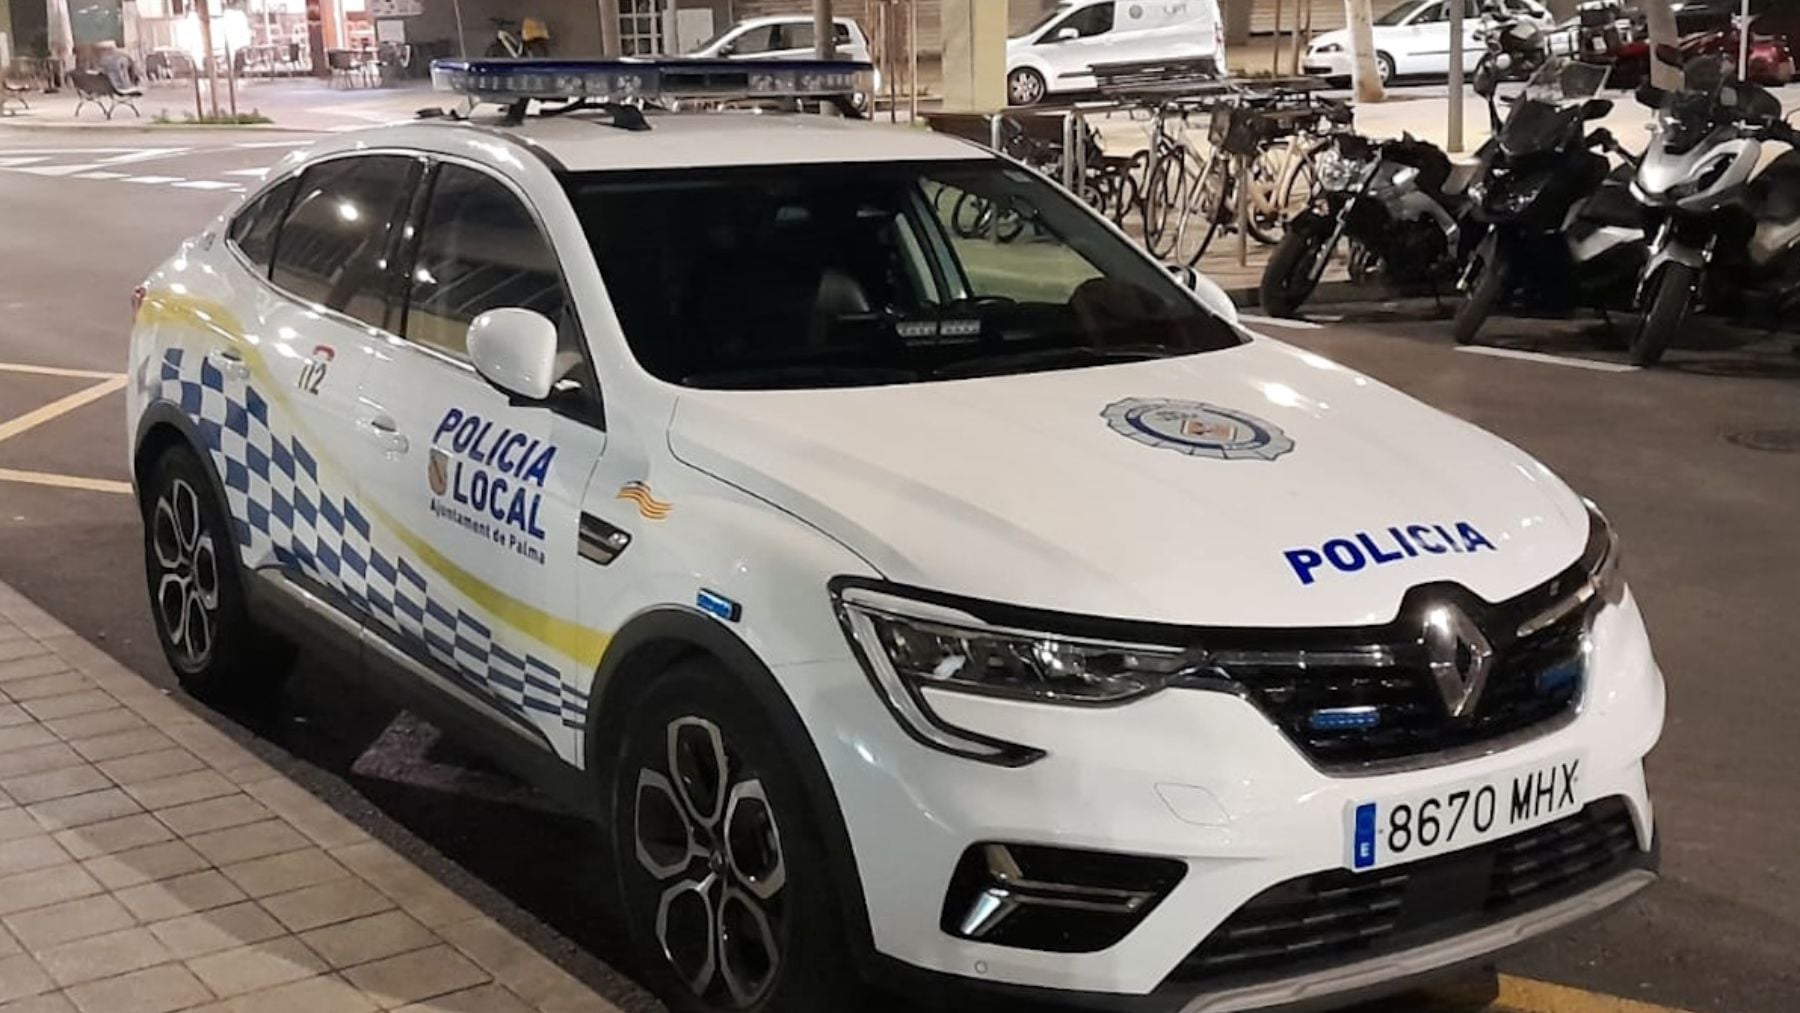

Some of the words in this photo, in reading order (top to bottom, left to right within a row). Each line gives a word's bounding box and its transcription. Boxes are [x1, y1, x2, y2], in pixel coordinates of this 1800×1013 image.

[432, 408, 558, 487] POLICIA
[430, 498, 490, 539] Ajuntament
[493, 527, 506, 546] de
[509, 533, 546, 565] Palma
[453, 461, 546, 540] LOCAL
[1283, 521, 1497, 585] POLICIA
[1388, 785, 1496, 853] 8670
[1509, 758, 1579, 824] MHX
[1360, 842, 1370, 857] E
